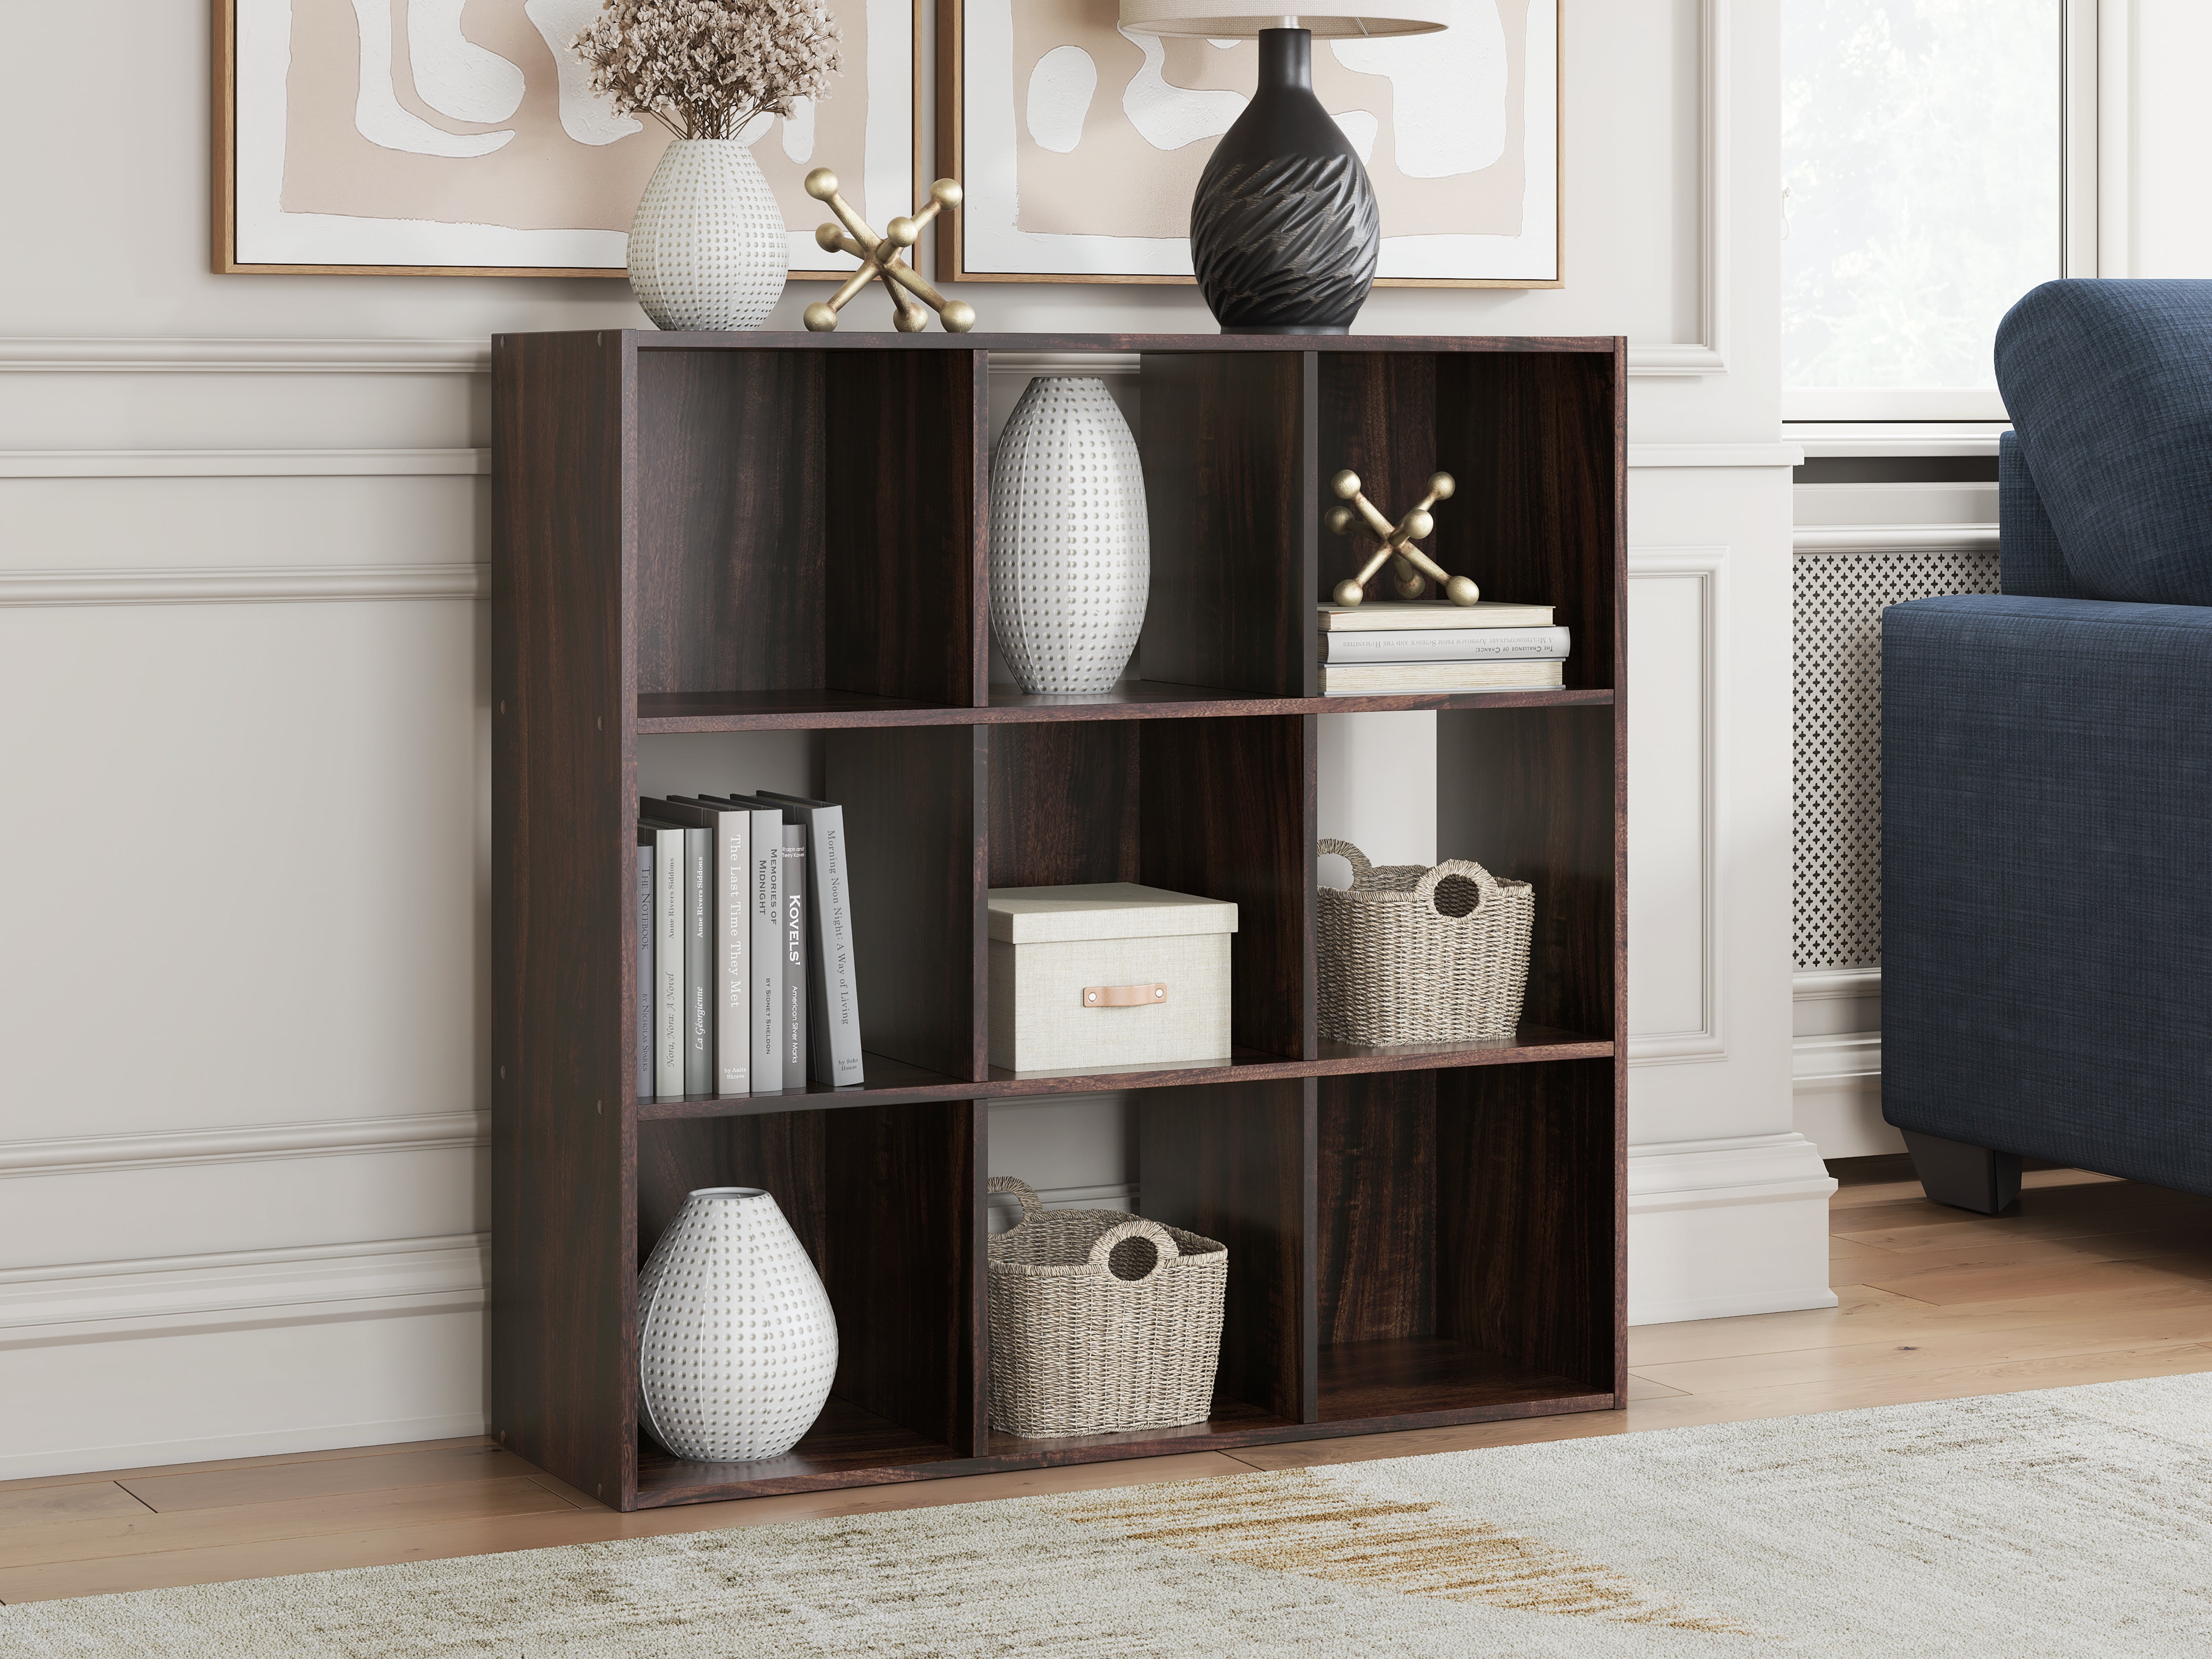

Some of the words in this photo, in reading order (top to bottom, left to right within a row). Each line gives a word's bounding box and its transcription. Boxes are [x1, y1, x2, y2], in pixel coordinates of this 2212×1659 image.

[730, 835, 741, 860] The
[827, 830, 836, 873] Morning
[641, 866, 650, 888] THE
[730, 866, 741, 897] Last
[831, 877, 839, 903] Noon
[641, 893, 650, 950] NOTEBOOK
[730, 901, 741, 936] Time
[771, 911, 777, 925] OF
[789, 895, 800, 965] KOVELS'
[833, 907, 842, 940] Night:
[728, 941, 741, 975] They
[837, 953, 846, 974] Way
[665, 971, 674, 1000] Novel
[730, 980, 741, 1007] Met
[766, 978, 771, 987] BY
[839, 979, 847, 988] of
[642, 994, 647, 1002] BY
[666, 1003, 675, 1012] A
[694, 987, 705, 1035] Géorgienne
[841, 992, 850, 1024] Living
[666, 1014, 674, 1039] Nora:
[666, 1042, 675, 1067] Nora,
[695, 1038, 703, 1050] La
